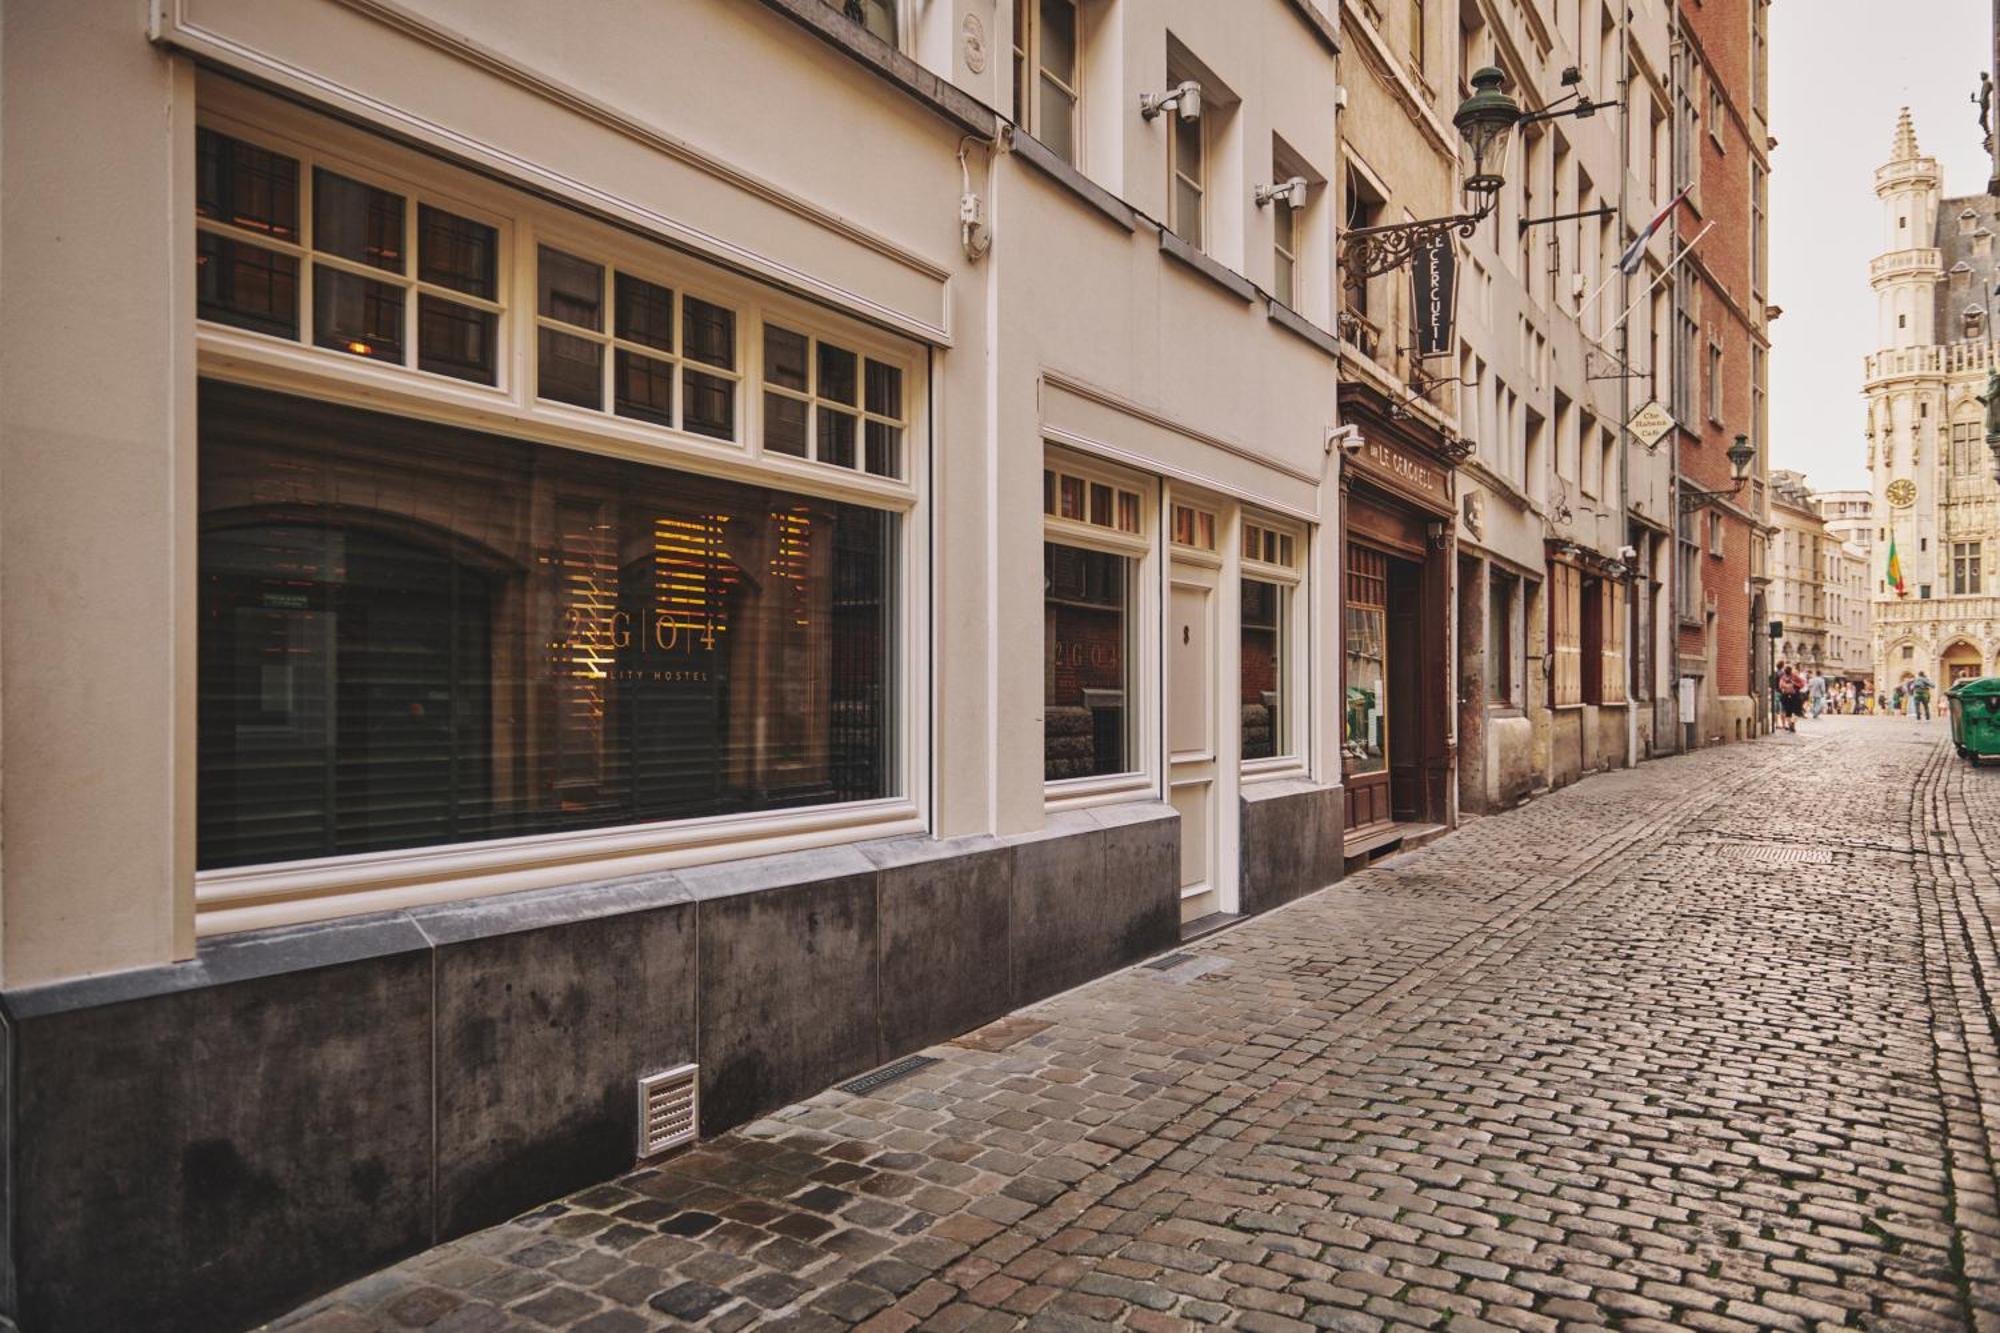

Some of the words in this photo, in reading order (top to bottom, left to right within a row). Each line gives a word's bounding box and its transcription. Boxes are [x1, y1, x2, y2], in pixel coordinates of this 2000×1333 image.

[1430, 249, 1441, 353] CERCUEIL
[1379, 444, 1391, 468] LE
[654, 671, 708, 681] HOSTEL
